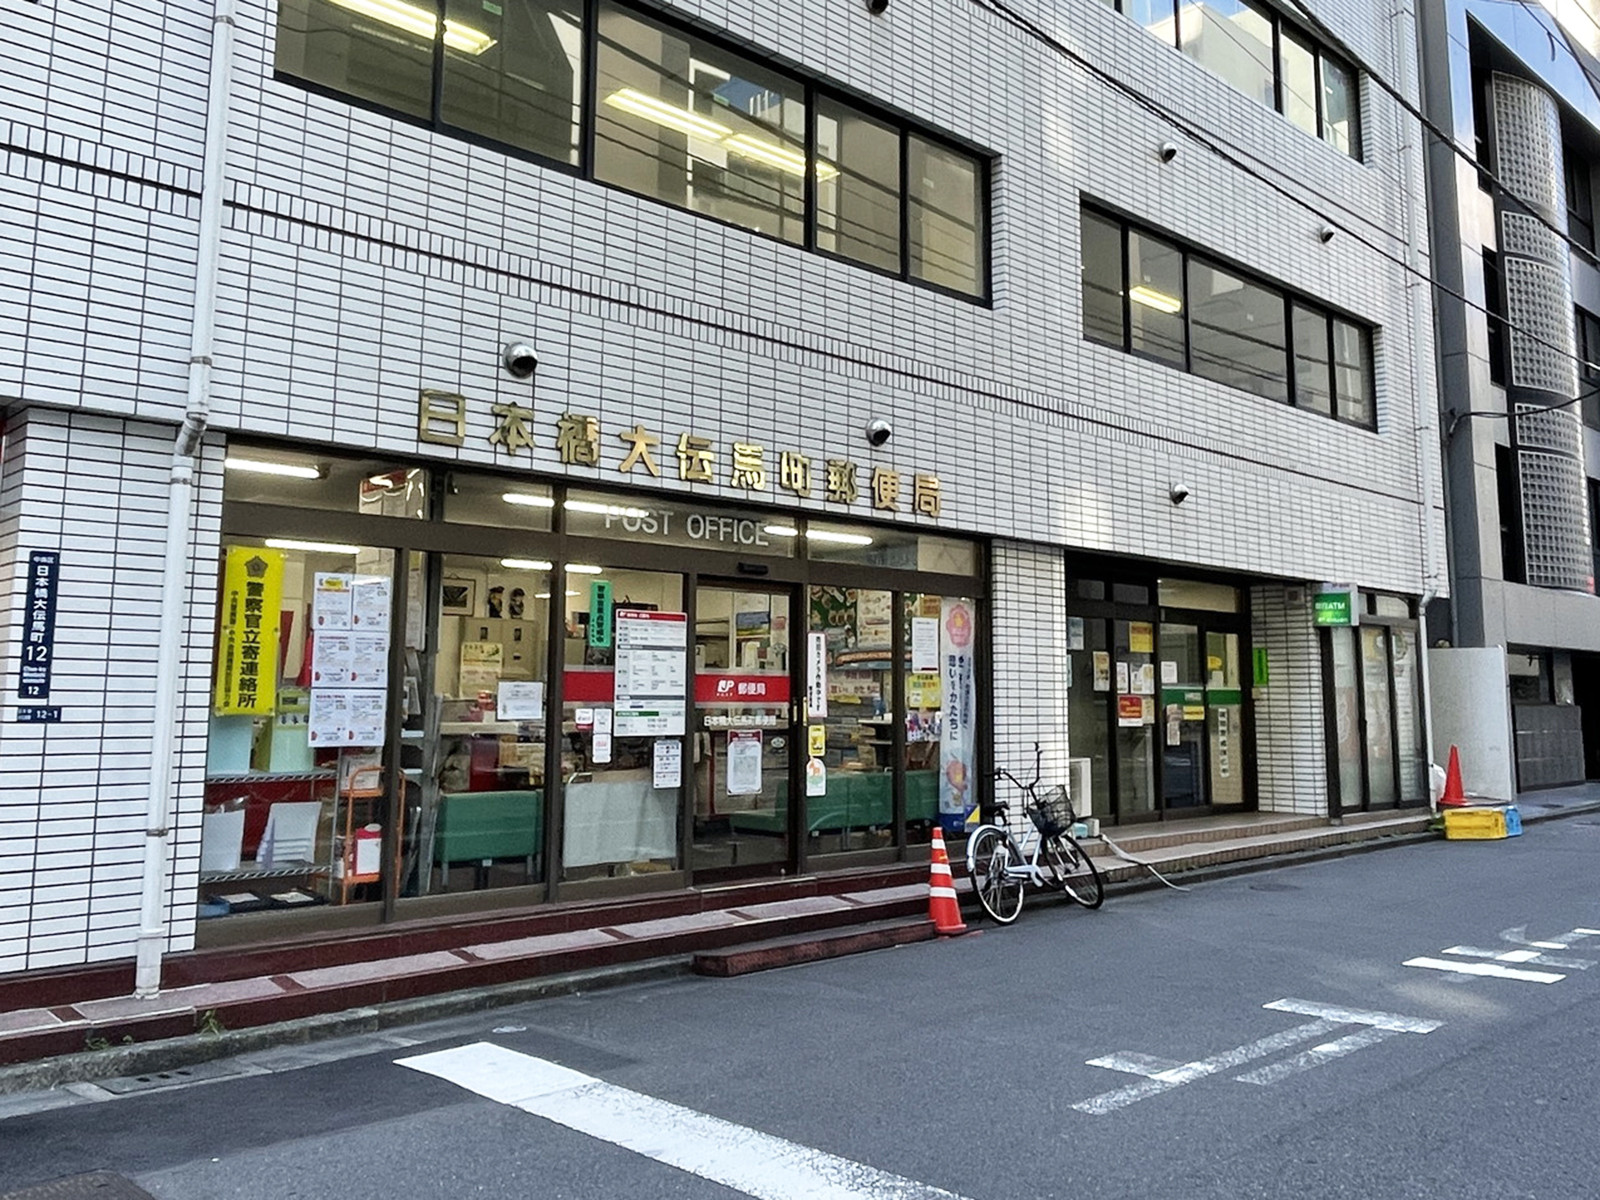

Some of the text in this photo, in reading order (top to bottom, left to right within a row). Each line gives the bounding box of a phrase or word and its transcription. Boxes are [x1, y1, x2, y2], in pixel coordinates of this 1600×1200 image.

[419, 388, 942, 519] 日本橋大伝馬町郵便局
[604, 504, 770, 547] POST OFFICE
[30, 565, 49, 644] 日本橋大伝馬町
[26, 645, 48, 662] 12
[237, 581, 264, 709] 警察官立寄連絡所
[28, 686, 39, 695] 12
[737, 682, 766, 695] 郵便局
[36, 709, 58, 719] 12-1
